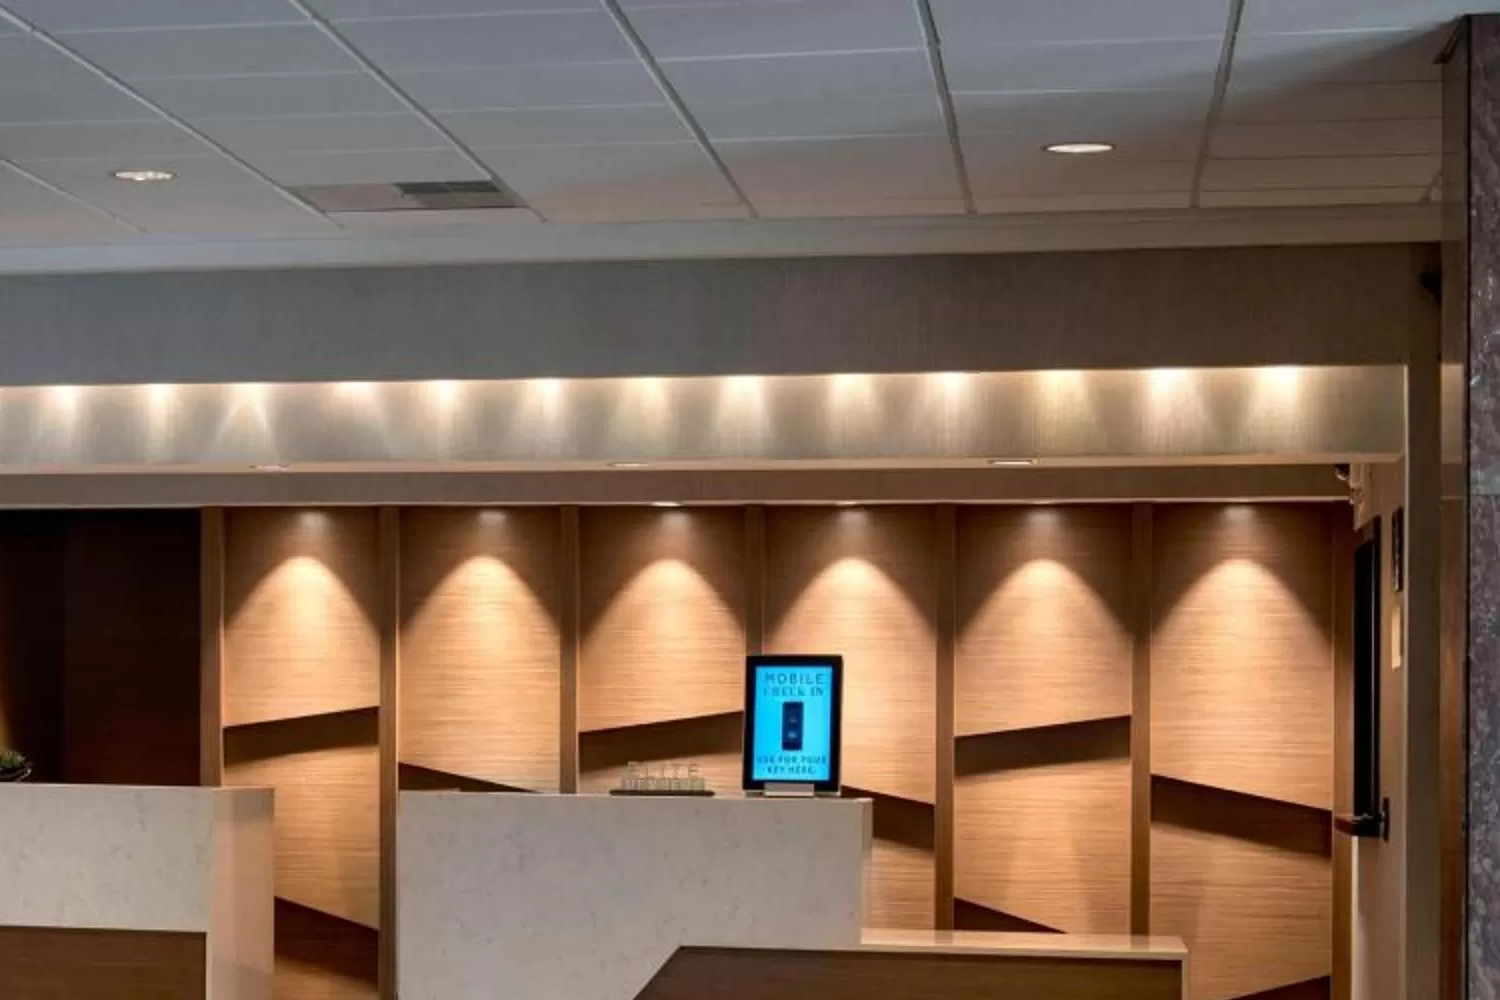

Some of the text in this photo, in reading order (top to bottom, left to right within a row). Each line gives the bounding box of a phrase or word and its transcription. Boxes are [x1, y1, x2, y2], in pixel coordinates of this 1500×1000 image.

[764, 672, 825, 685] MOBILE
[763, 686, 824, 697] CHECK IN
